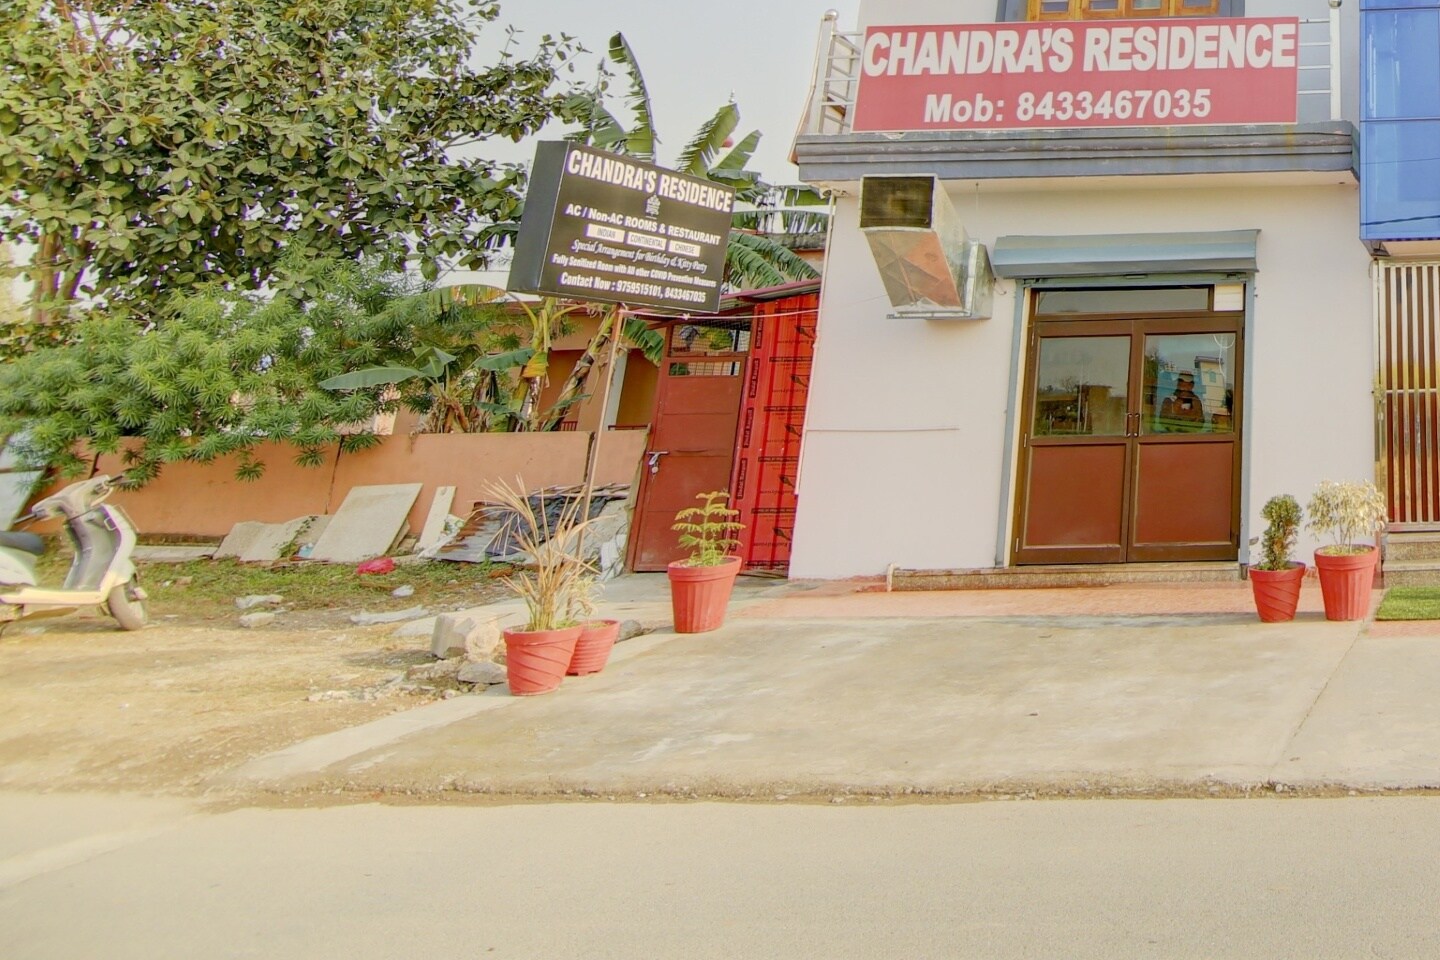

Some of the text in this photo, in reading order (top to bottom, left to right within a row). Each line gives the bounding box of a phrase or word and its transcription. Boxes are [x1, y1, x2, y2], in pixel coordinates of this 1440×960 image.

[863, 24, 1296, 77] CHANDRA'S RESIDENCE
[923, 88, 1212, 123] Mob: 8433467035
[568, 150, 733, 213] CHANDRA'S RESIDENCE
[565, 203, 582, 216] AC
[588, 208, 623, 224] Non-AC
[624, 215, 658, 232] ROOMS
[659, 223, 666, 234] &
[668, 225, 721, 245] RESTAURANT
[552, 253, 569, 267] Fully
[614, 263, 627, 273] with
[571, 239, 598, 253] Special
[595, 243, 635, 259] Arrangement
[633, 249, 645, 262] for
[561, 272, 593, 287] Contact
[593, 276, 611, 291] Now
